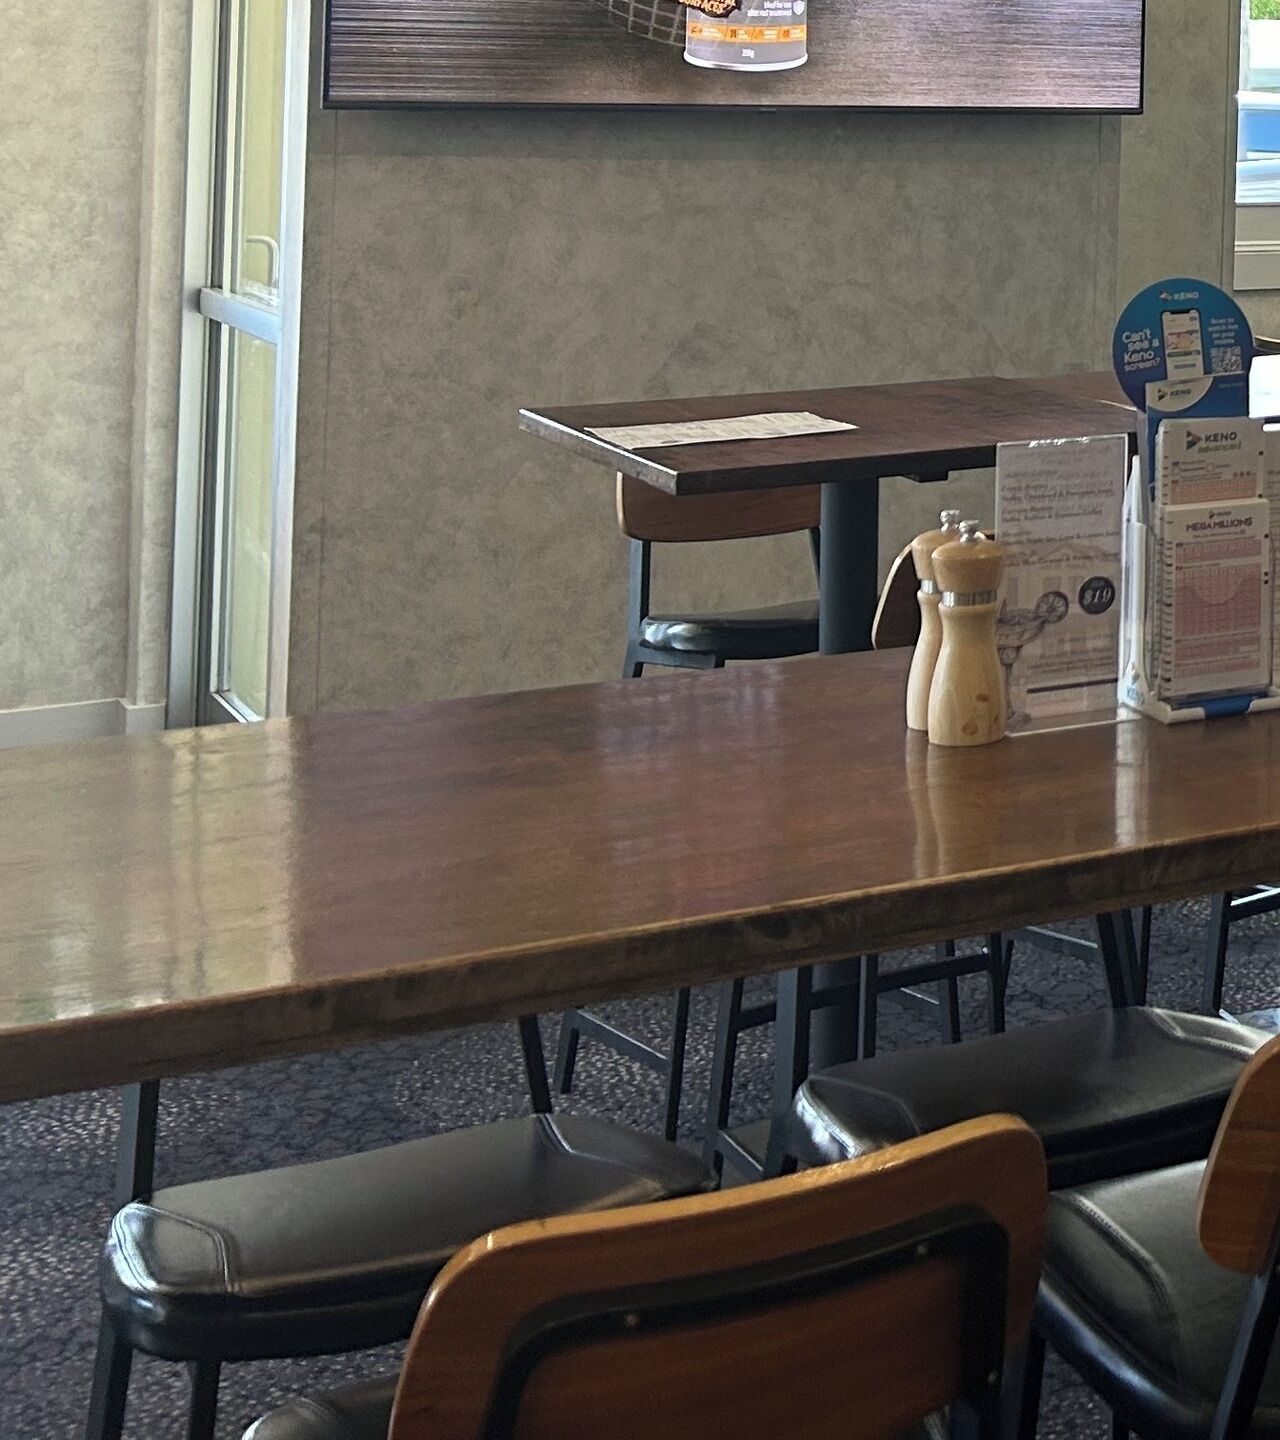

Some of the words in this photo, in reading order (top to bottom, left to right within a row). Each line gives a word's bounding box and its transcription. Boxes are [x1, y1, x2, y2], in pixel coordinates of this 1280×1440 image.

[1122, 328, 1151, 343] Can't
[1127, 340, 1149, 352] see
[1152, 338, 1159, 347] a
[1124, 350, 1155, 363] Keno
[1124, 357, 1160, 371] screen?
[1204, 431, 1237, 443] KENO
